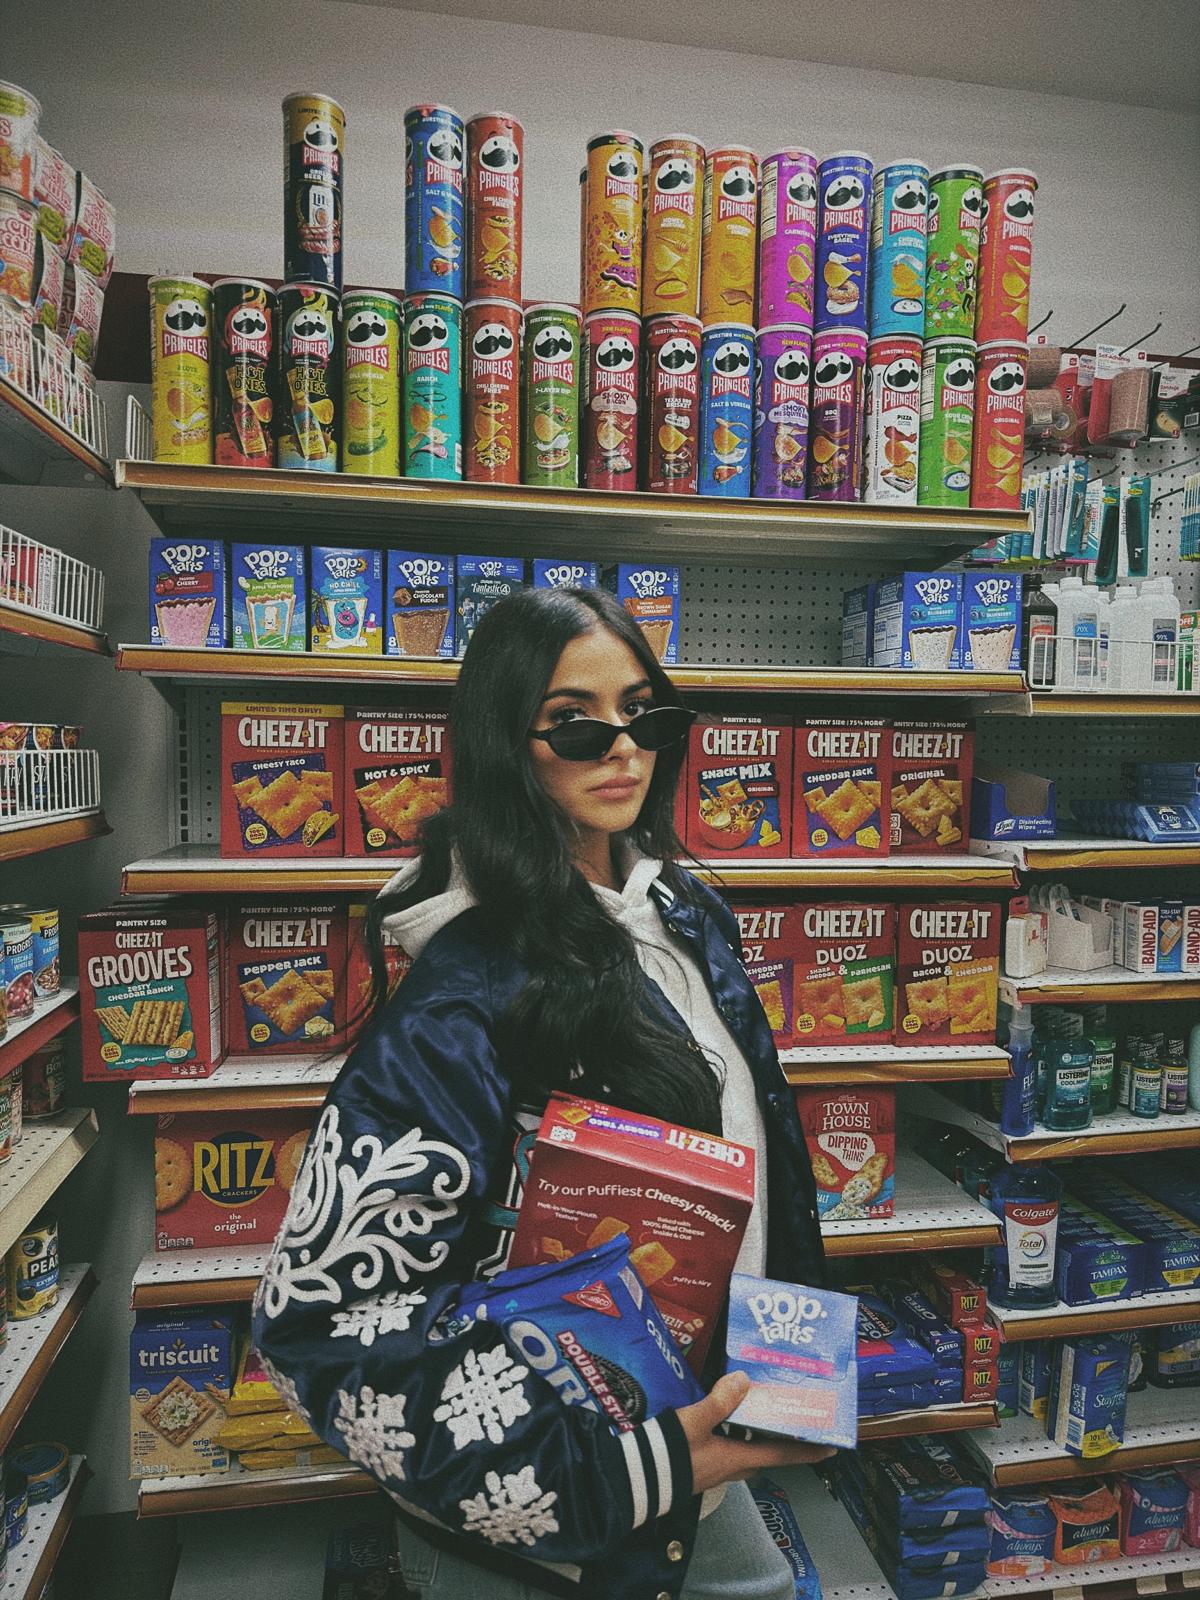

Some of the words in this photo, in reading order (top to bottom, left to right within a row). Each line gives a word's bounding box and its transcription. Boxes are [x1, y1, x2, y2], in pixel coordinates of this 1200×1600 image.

[480, 171, 519, 197] PRINGLES
[607, 179, 639, 201] PRINGLES
[654, 194, 694, 216] PRINGLES
[824, 210, 864, 235] PRINGLES
[164, 332, 208, 361] PRINGLES
[232, 335, 268, 360] PRINGLES
[292, 335, 328, 360] PRINGLES
[347, 347, 387, 373] PRINGLES
[409, 349, 449, 372] PRINGLES
[238, 365, 264, 381] HOT
[297, 365, 325, 381] HOT
[473, 360, 513, 383] PRINGLES
[533, 361, 573, 384] PRINGLES
[235, 379, 266, 395] ONES
[293, 379, 326, 395] ONES
[596, 372, 634, 395] PRINGLES
[658, 373, 696, 397] PRINGLES
[713, 375, 751, 398] PRINGLES
[602, 391, 630, 402] SMOKY
[814, 384, 852, 407] PRINGLES
[987, 395, 1023, 414] PRINGLES
[246, 704, 277, 713] LIMITED
[356, 711, 386, 719] PANTRY
[387, 711, 404, 719] SIZE
[408, 712, 424, 720] 75%
[252, 761, 287, 772] CHEESY
[287, 759, 306, 767] TACO
[364, 770, 389, 781] HOT
[390, 768, 399, 779] &
[400, 765, 431, 777] SPICY
[702, 766, 738, 781] SNACK
[739, 762, 773, 780] MIX
[807, 768, 849, 783] CHEDDAR
[850, 767, 875, 778] JACK
[899, 770, 945, 781] ORIGINAL
[747, 786, 774, 794] ORIGINAL
[1017, 818, 1052, 826] Disinfecting
[240, 906, 270, 915] PANTRY
[272, 906, 289, 914] SIZE
[116, 920, 147, 928] PANTRY
[149, 919, 167, 927] SIZE
[816, 944, 867, 965] DUOZ
[922, 945, 973, 966] DUOZ
[87, 946, 193, 987] GROOVES
[243, 960, 292, 977] PEPPER
[293, 954, 322, 967] JACK
[809, 966, 831, 975] SHARP
[838, 965, 848, 977] &
[850, 963, 892, 977] PARMESAN
[912, 966, 943, 978] BACON
[943, 965, 953, 977] &
[955, 965, 993, 978] CHEDDAR
[757, 970, 776, 980] JACK
[806, 971, 835, 981] CHEDDAR
[107, 989, 147, 1002] CHEDDAR
[147, 984, 174, 995] RANCH
[127, 984, 152, 993] ZESTY
[1059, 1070, 1089, 1080] LISTERINE
[823, 1101, 869, 1117] TOWN
[588, 1116, 617, 1130] TACO
[823, 1115, 871, 1131] HOUSE
[621, 1123, 661, 1140] CHEESY
[828, 1135, 868, 1151] DIPPING
[842, 1149, 864, 1163] THINS
[193, 1140, 276, 1193] RITZ
[222, 1189, 258, 1197] CRACKERS
[537, 1201, 598, 1220] Melt-in-Your-Mouth
[538, 1178, 560, 1201] Try
[561, 1186, 585, 1197] our
[587, 1186, 643, 1199] Puffiest
[645, 1188, 694, 1214] Cheesy
[692, 1204, 737, 1234] Snack!
[1012, 1207, 1055, 1219] Colgate
[229, 1213, 242, 1222] the
[555, 1211, 579, 1222] Texture
[656, 1215, 673, 1225] Baked
[674, 1219, 692, 1228] with
[214, 1218, 257, 1234] original
[641, 1219, 660, 1230] 100%
[661, 1223, 676, 1233] Real
[677, 1226, 706, 1237] Cheese
[653, 1228, 672, 1238] Inside
[679, 1232, 693, 1242] Out
[1018, 1240, 1042, 1249] Total
[1163, 1253, 1200, 1269] TAMPAX
[1091, 1264, 1127, 1280] TAMPAX
[672, 1275, 692, 1286] Puffy
[697, 1280, 713, 1290] Airy
[960, 1296, 980, 1311] RITZ
[759, 1321, 816, 1346] tarts
[646, 1319, 684, 1380] OREO
[936, 1343, 959, 1353] OREO
[974, 1336, 993, 1351] RITZ
[138, 1343, 219, 1367] triscuit
[557, 1330, 606, 1396] DOUBLE
[601, 1394, 634, 1433] STUF
[973, 1370, 991, 1386] RITZ
[1145, 1512, 1180, 1527] always
[1072, 1523, 1111, 1541] always
[1006, 1538, 1044, 1554] always
